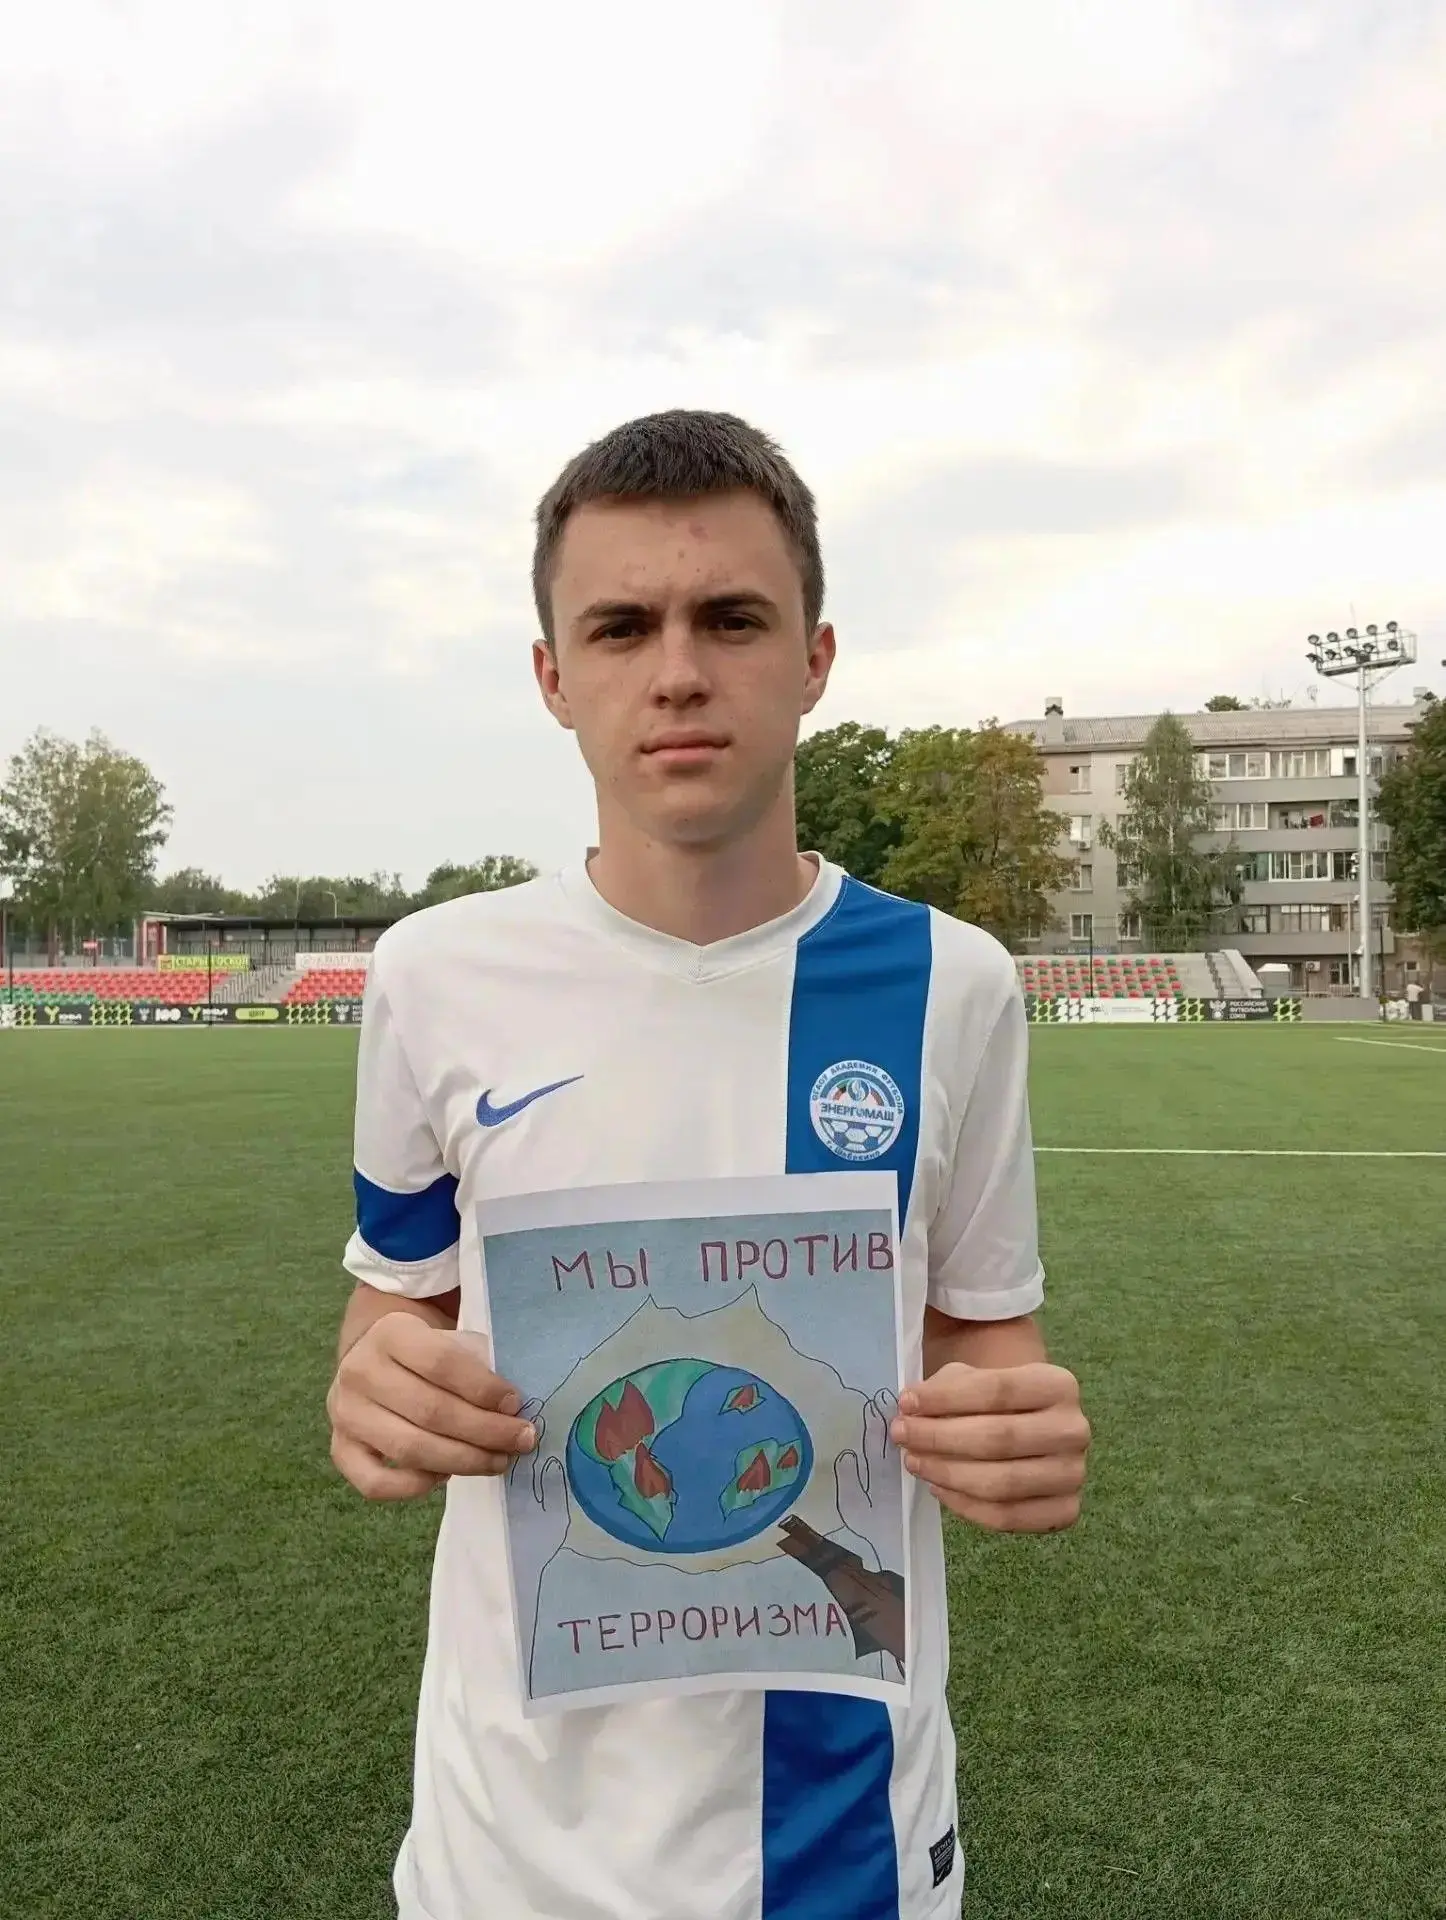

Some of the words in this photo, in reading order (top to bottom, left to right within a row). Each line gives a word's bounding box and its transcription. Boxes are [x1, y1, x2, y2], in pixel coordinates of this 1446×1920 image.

[551, 1247, 650, 1292] МЫ
[700, 1232, 895, 1284] ПРОТИВ
[557, 1602, 848, 1655] ТЕРРОРИЗМА
